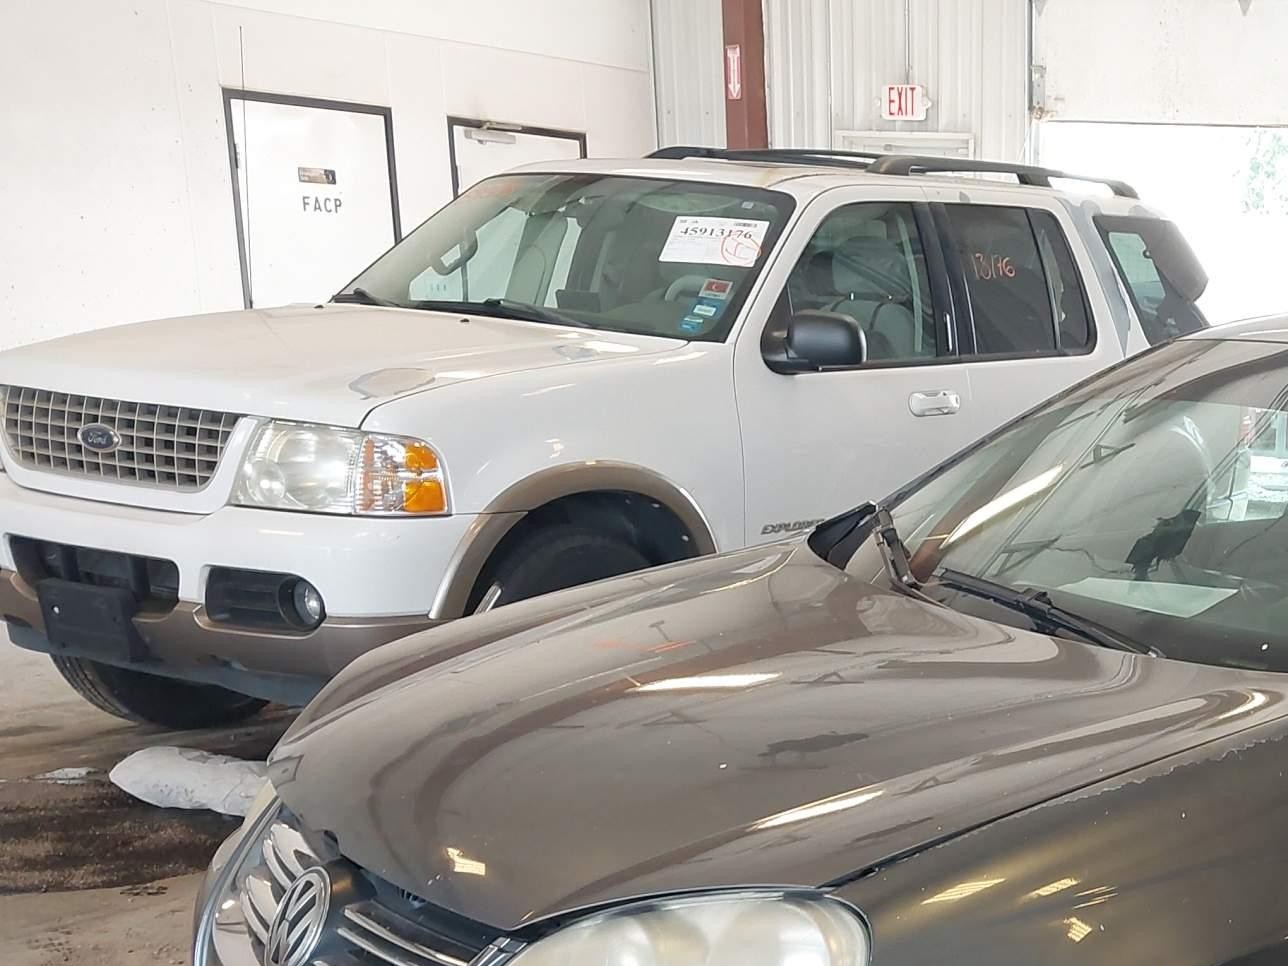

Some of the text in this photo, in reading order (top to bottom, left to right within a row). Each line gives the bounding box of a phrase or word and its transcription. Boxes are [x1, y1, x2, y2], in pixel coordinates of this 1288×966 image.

[888, 86, 916, 116] EXIT
[302, 195, 342, 213] FACP
[680, 226, 752, 239] 45913176
